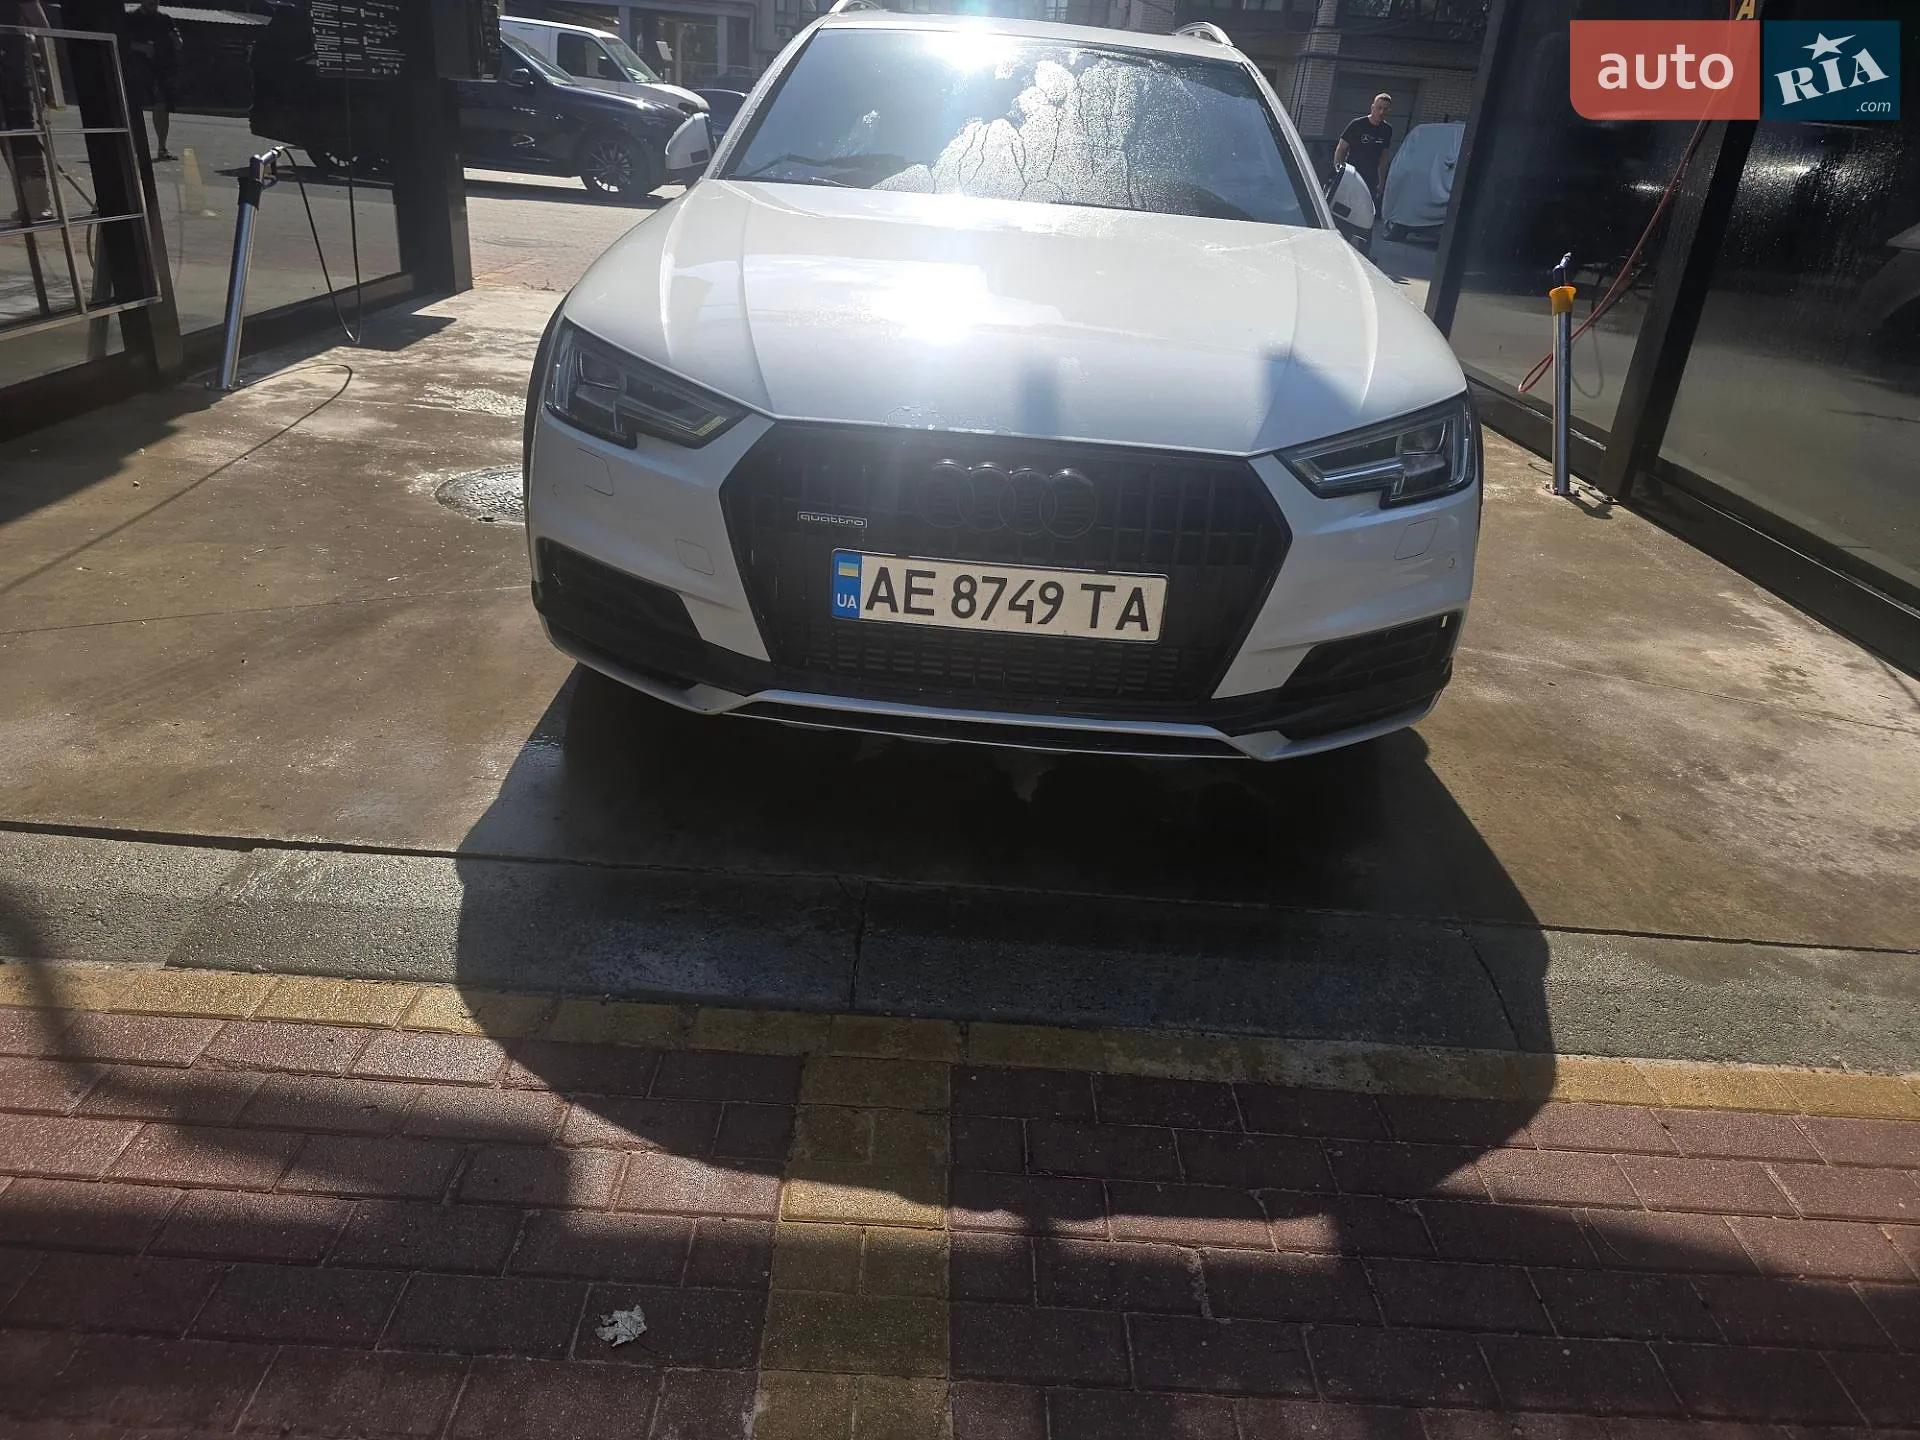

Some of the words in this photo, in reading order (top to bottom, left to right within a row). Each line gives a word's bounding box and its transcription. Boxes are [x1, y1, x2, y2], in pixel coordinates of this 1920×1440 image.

[799, 513, 864, 527] quattro
[836, 592, 857, 609] UA
[864, 566, 936, 617] AE
[950, 573, 1065, 625] 8749
[1080, 583, 1150, 632] TA
